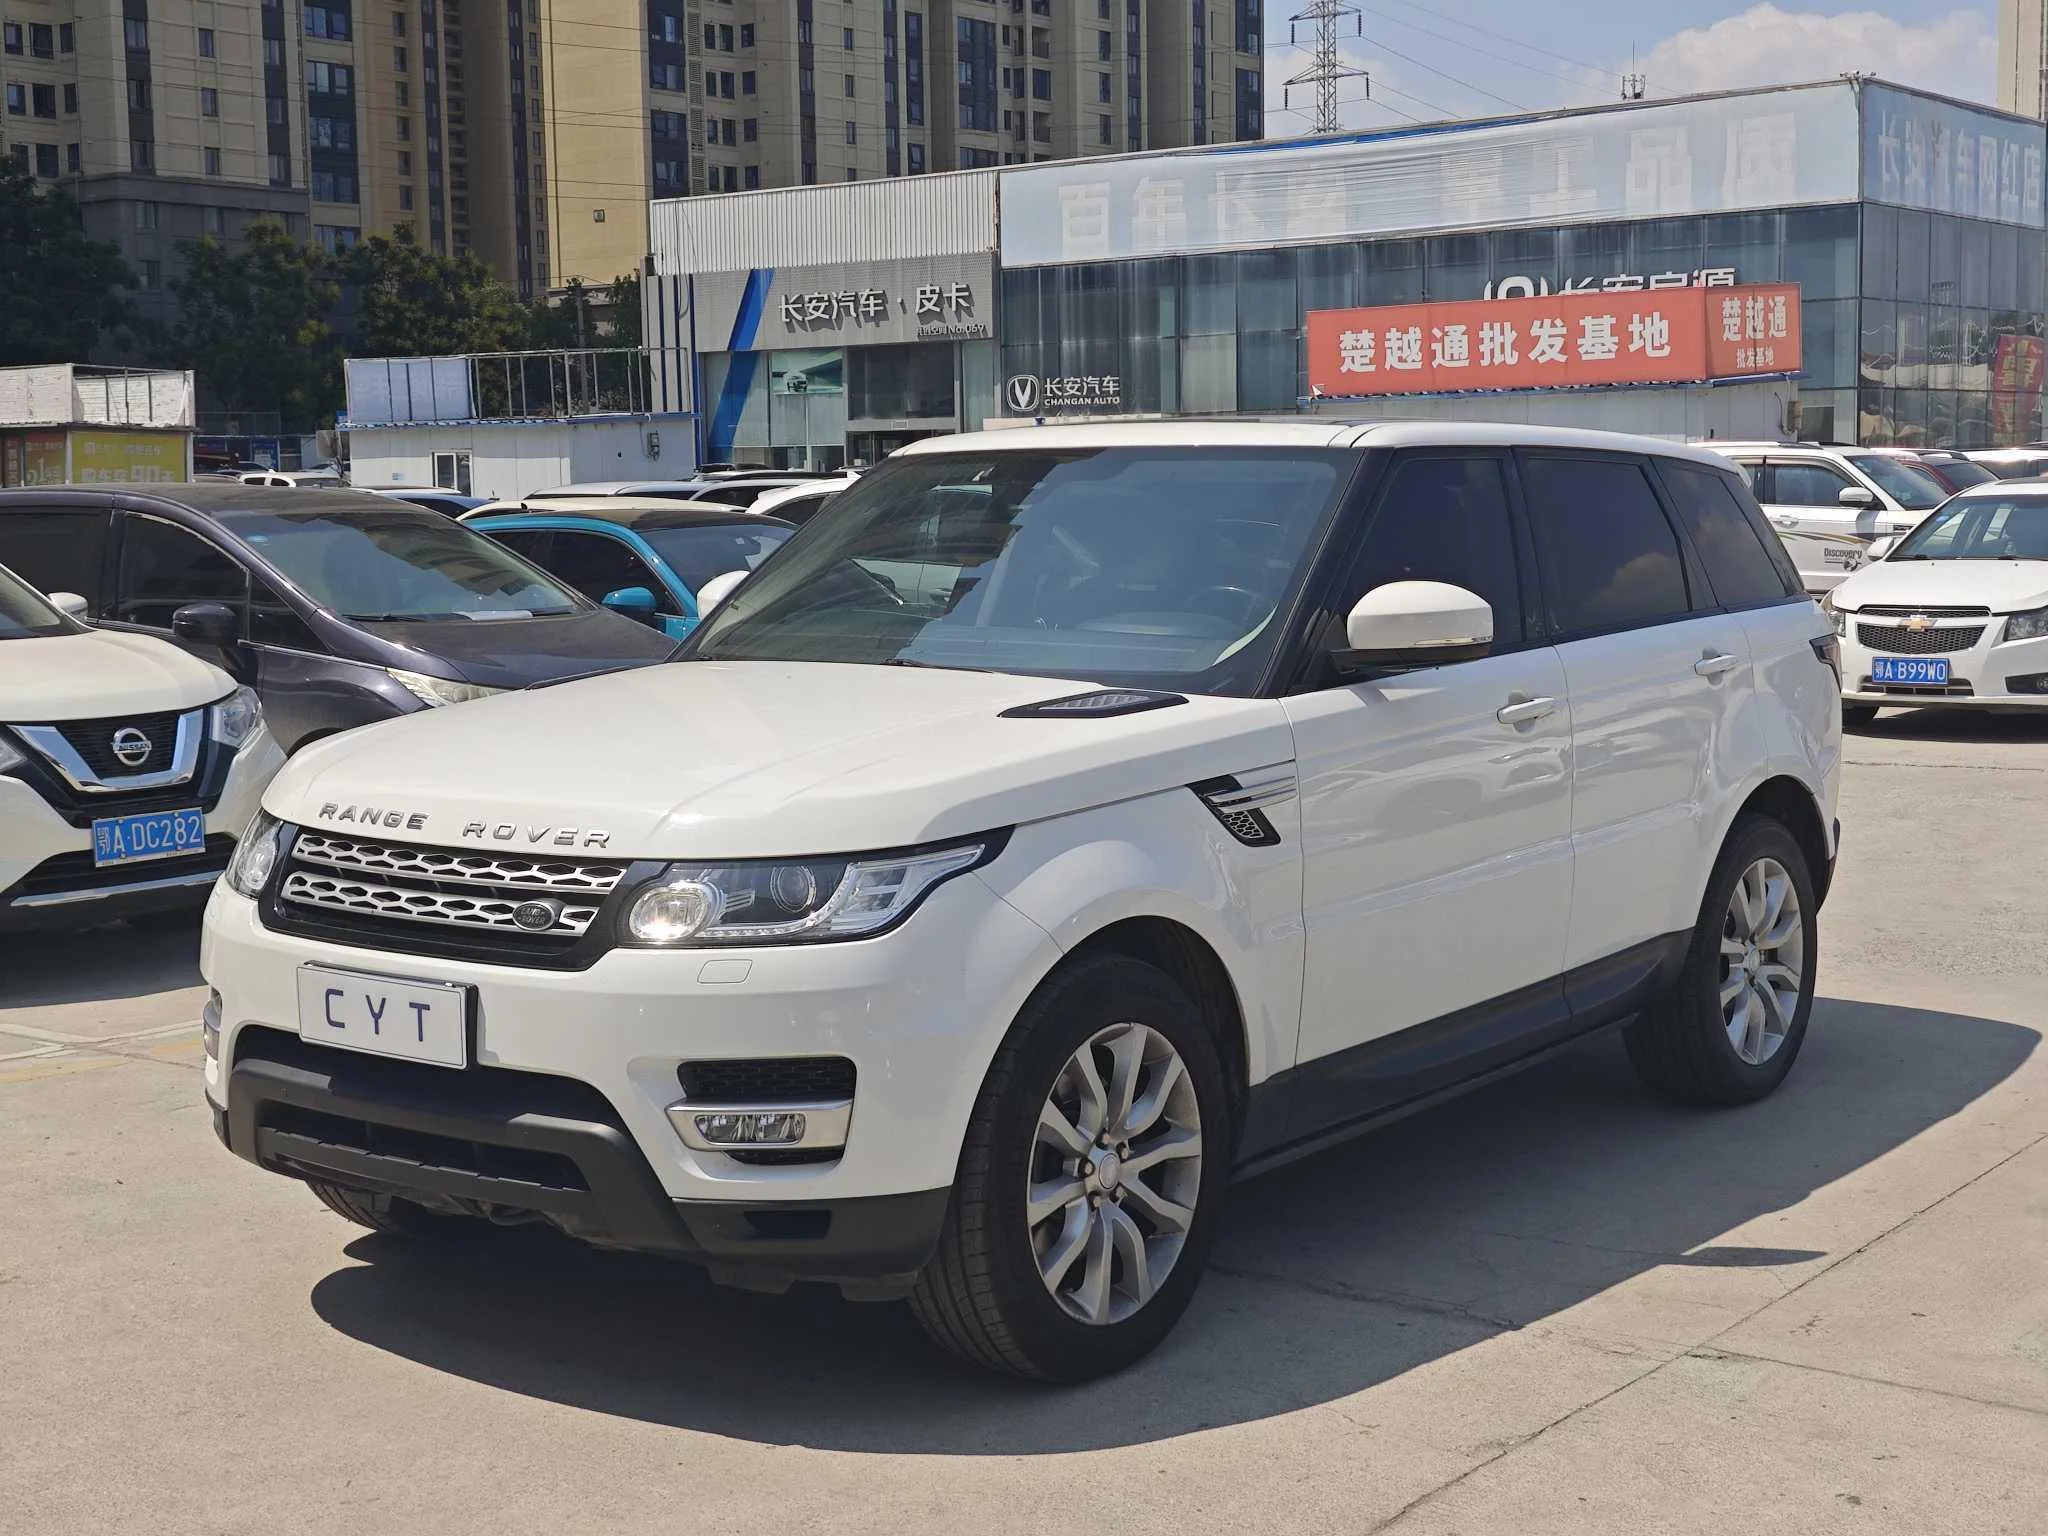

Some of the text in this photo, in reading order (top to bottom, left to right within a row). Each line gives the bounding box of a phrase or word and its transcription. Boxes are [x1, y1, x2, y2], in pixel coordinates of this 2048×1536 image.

[1722, 295, 1787, 341] 楚越通
[1339, 311, 1671, 374] 楚越通批发基地
[1736, 344, 1775, 369] 批发基地
[1044, 375, 1120, 397] 长安汽车
[1044, 396, 1120, 406] CHANGAN AUTO
[119, 742, 150, 752] NISSAN
[318, 802, 611, 849] RANGE ROVER
